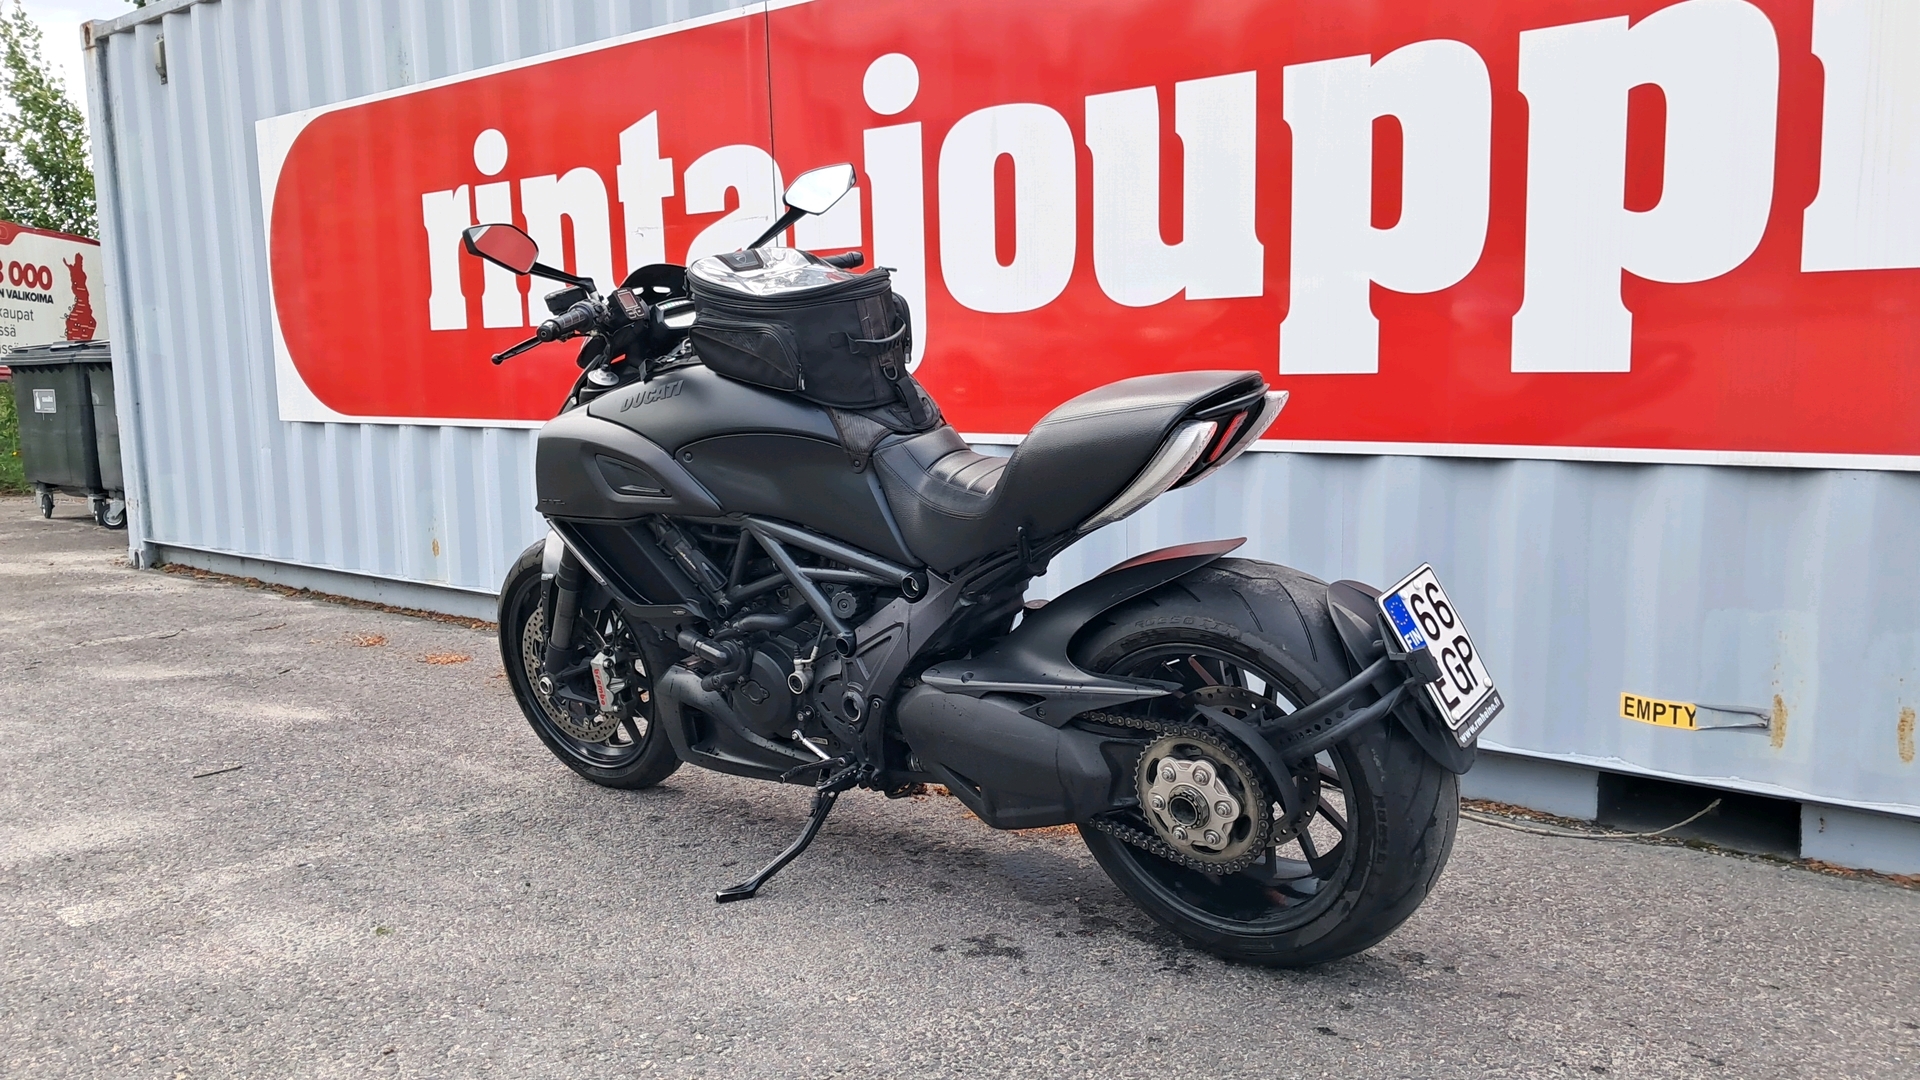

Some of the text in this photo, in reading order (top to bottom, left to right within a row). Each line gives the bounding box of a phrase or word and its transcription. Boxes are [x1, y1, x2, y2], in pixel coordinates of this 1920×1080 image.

[6, 288, 54, 305] VALIKOIMA
[620, 380, 684, 413] DUCATI
[1410, 582, 1455, 641] 66
[1404, 626, 1424, 650] FIN
[593, 668, 606, 706] brembo
[1459, 695, 1501, 744] www.rmheino.fi
[1624, 696, 1697, 727] EMPTY
